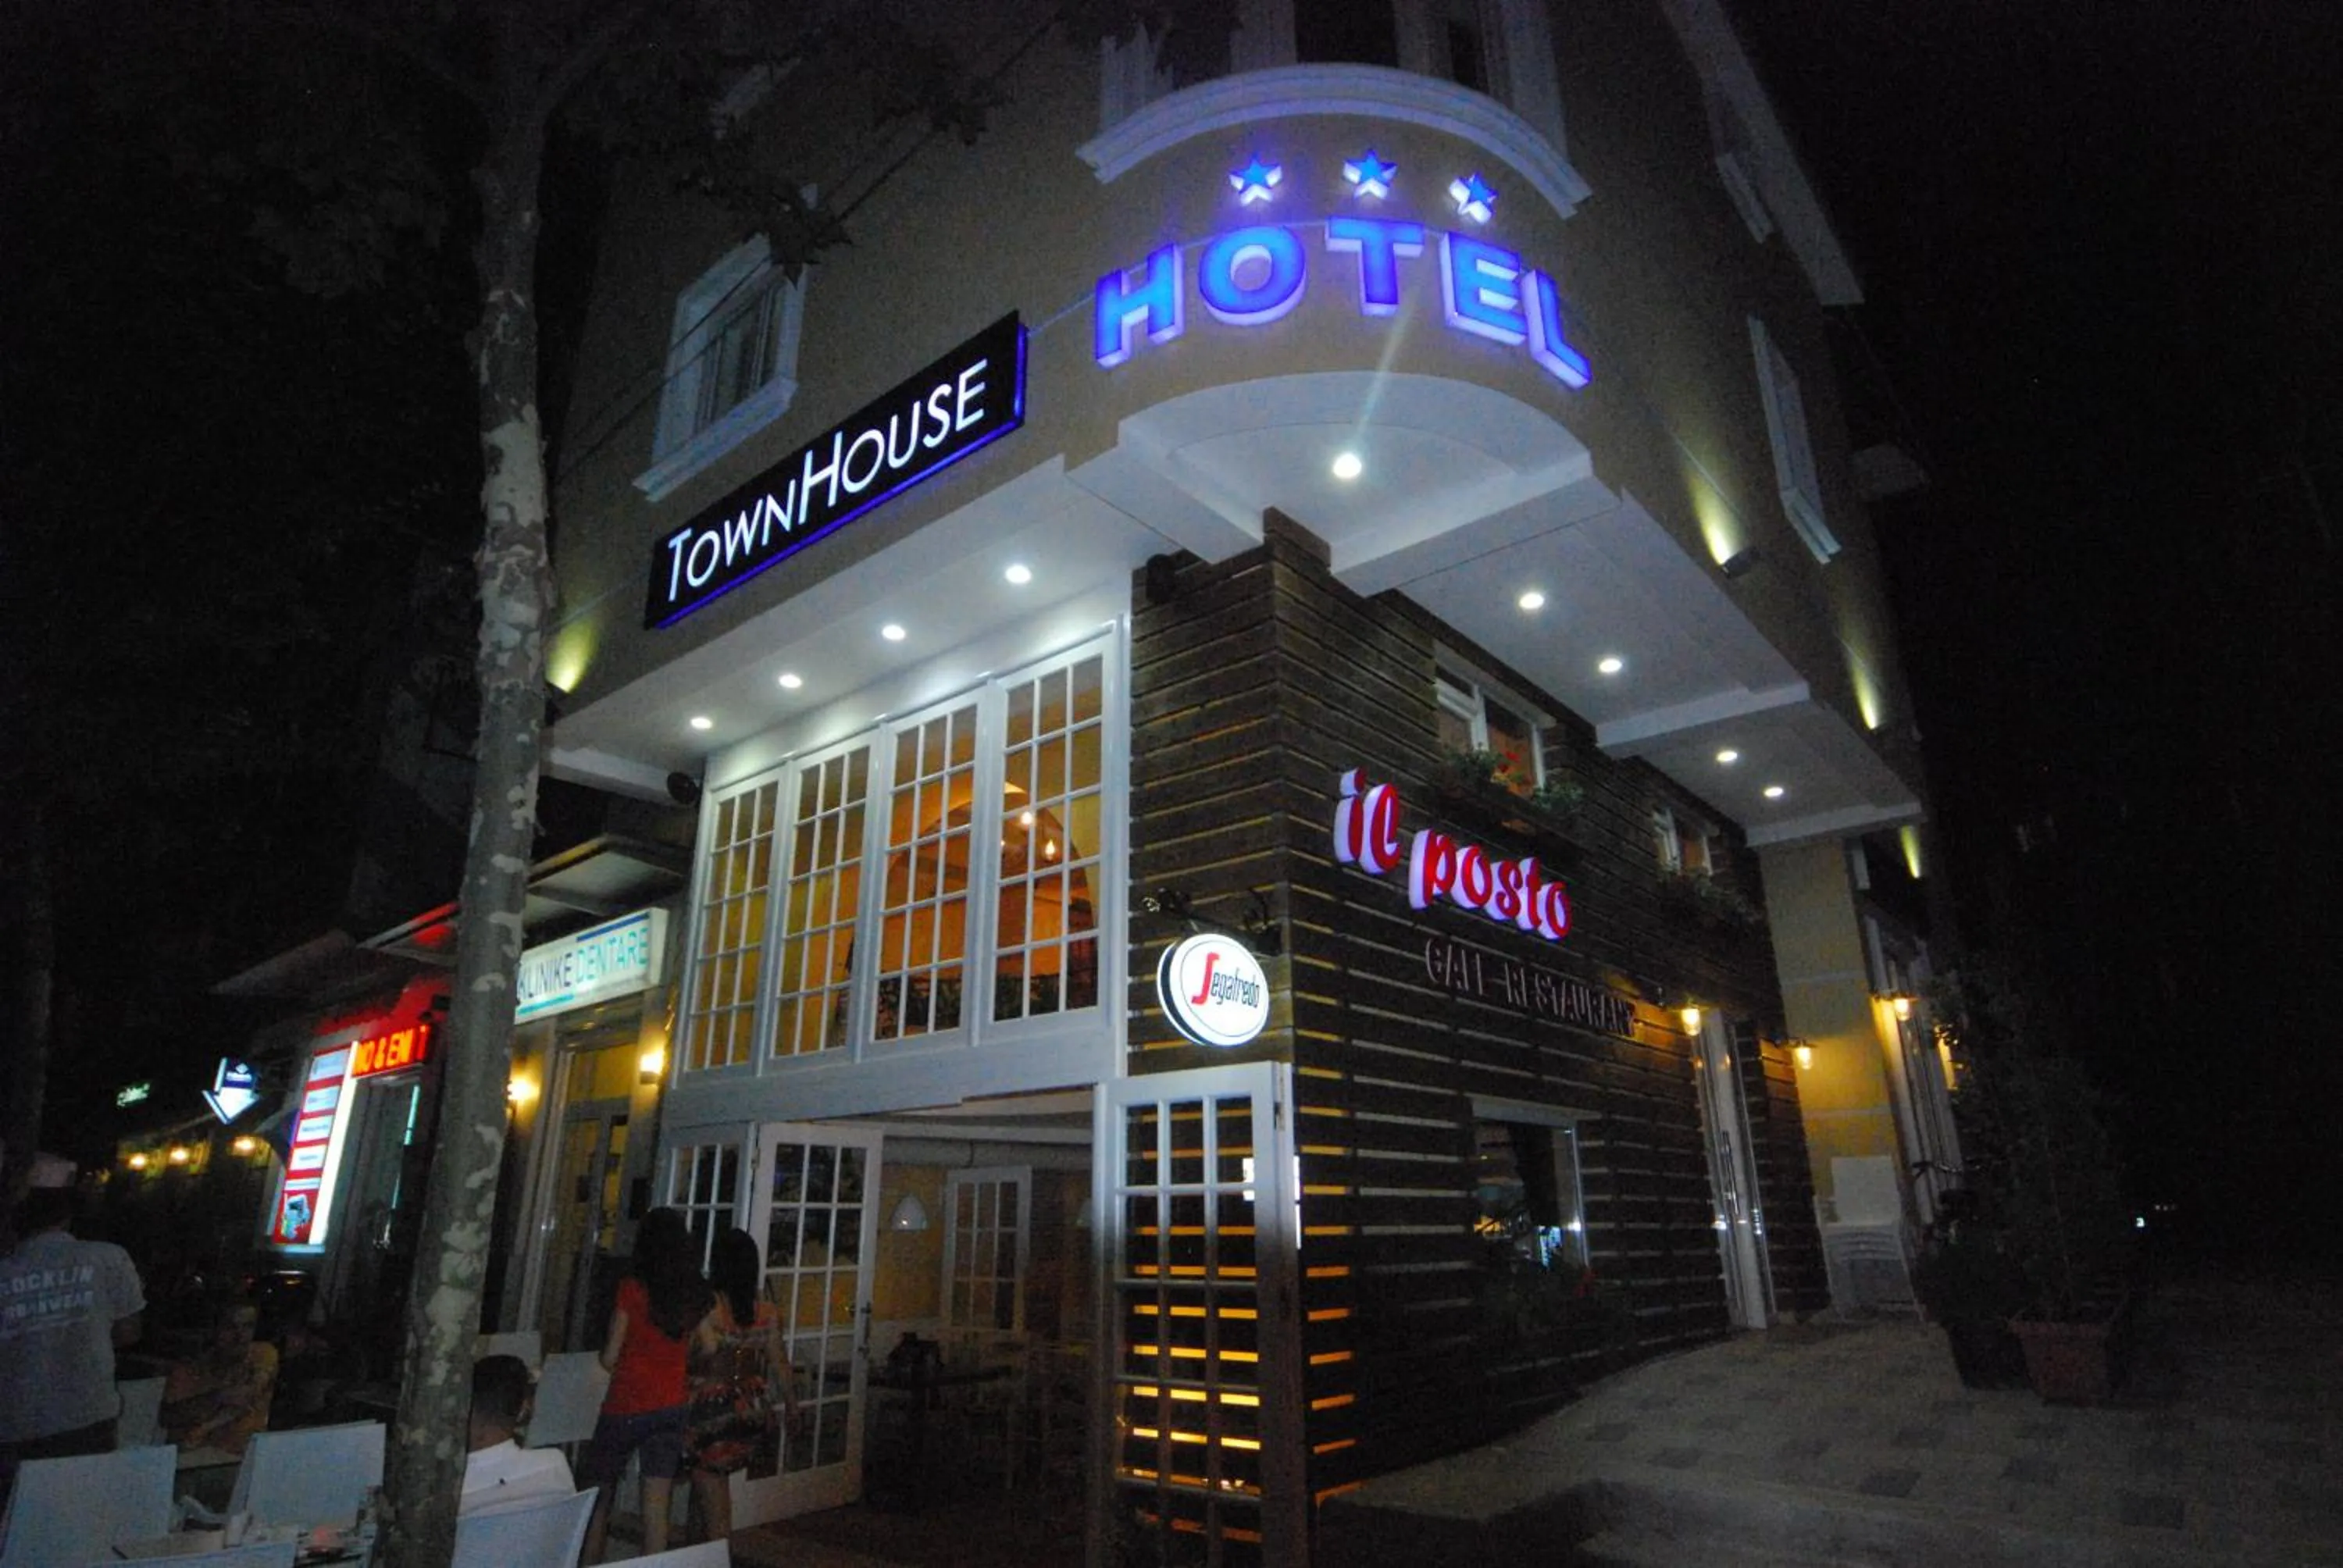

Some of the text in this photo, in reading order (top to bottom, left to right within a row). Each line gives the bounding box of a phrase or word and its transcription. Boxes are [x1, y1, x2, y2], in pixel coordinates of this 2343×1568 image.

[1095, 214, 1593, 390] HOTEL
[1333, 767, 1573, 940] il posto
[575, 926, 649, 984] DENTARE
[1191, 952, 1261, 1009] Segafredo
